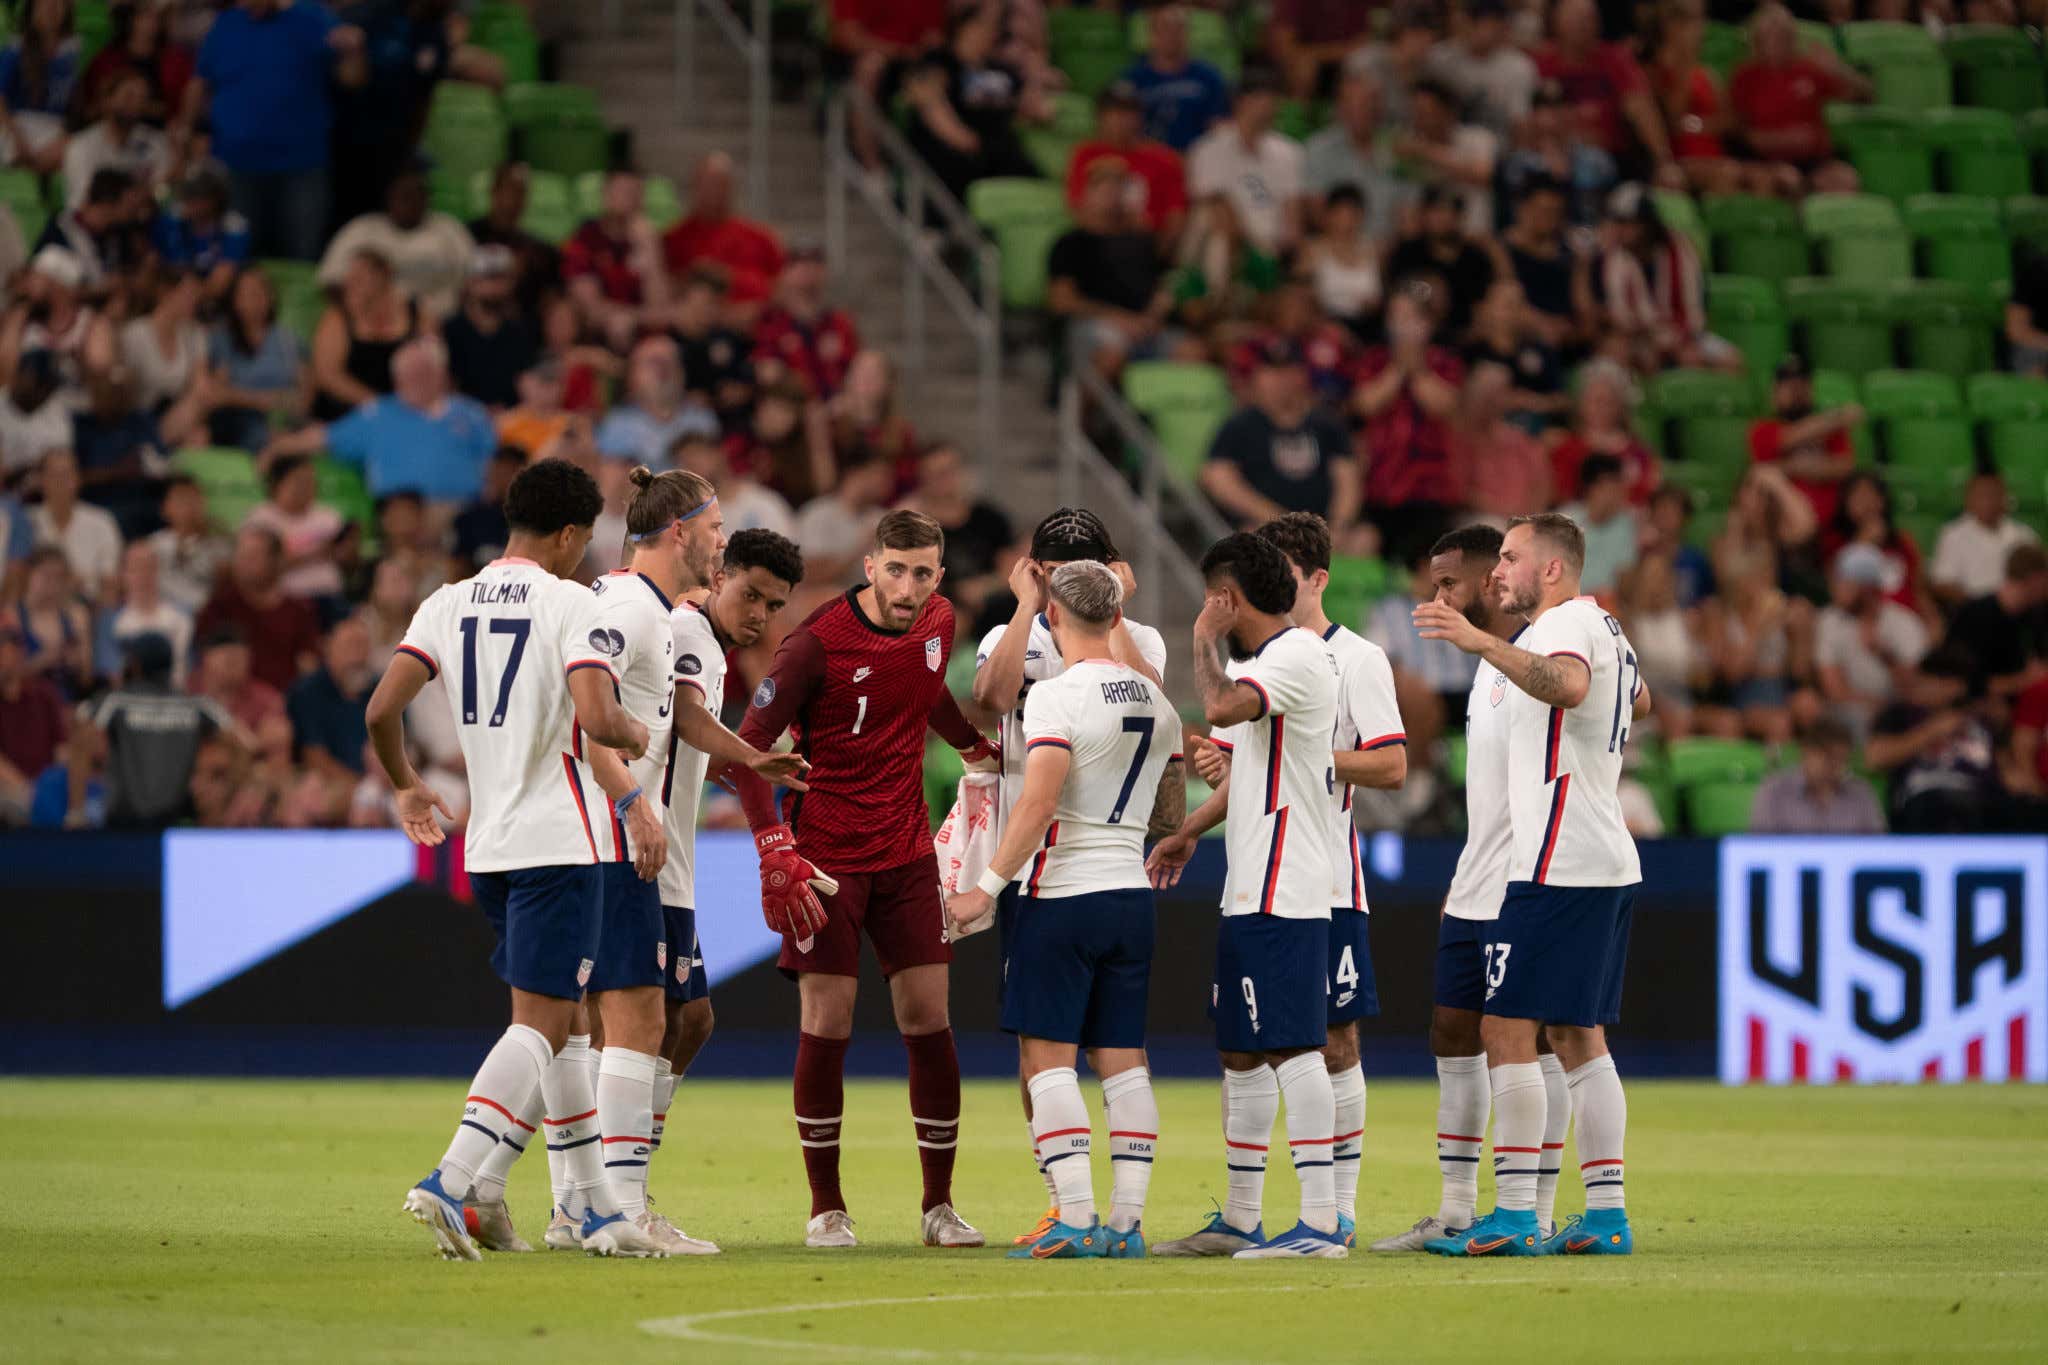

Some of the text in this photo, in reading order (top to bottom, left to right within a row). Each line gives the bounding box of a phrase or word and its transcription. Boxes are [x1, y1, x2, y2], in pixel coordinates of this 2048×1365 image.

[471, 582, 531, 604] TILLMAN
[459, 616, 532, 728] 17
[1101, 680, 1153, 706] ARRIOLA
[851, 696, 868, 735] 1
[1106, 716, 1156, 824] 7
[1749, 868, 2026, 1042] USA
[1241, 976, 1258, 1022] 9
[1129, 1141, 1152, 1152] USA
[1602, 1168, 1621, 1176] USA
